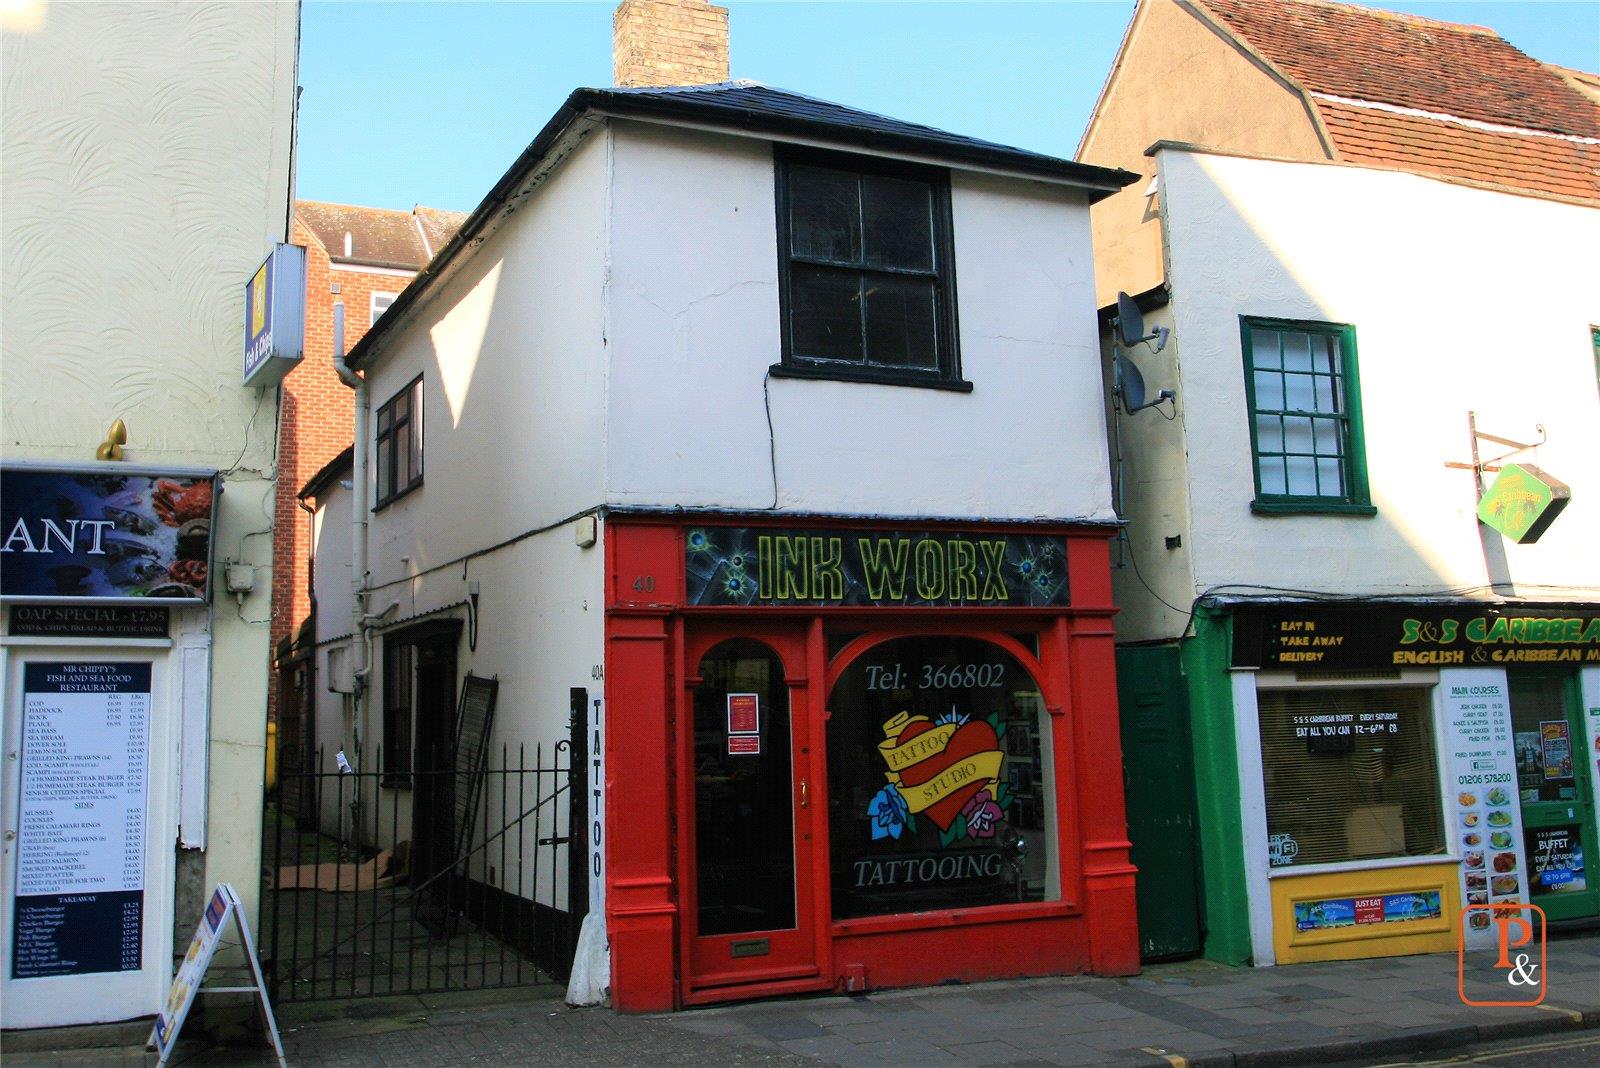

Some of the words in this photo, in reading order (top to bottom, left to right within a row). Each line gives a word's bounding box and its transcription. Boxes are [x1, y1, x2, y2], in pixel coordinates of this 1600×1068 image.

[758, 535, 844, 600] INK
[858, 538, 1009, 601] WORX
[632, 576, 656, 592] 40
[18, 608, 51, 620] OAP
[55, 608, 120, 621] SPECIAL
[1281, 621, 1303, 631] EAT
[1305, 622, 1315, 631] IN
[1400, 618, 1459, 644] S&S
[1280, 636, 1310, 646] TAKE
[1312, 636, 1344, 646] AWAY
[1280, 652, 1324, 662] DELIVERY
[1393, 650, 1464, 664] ENGLISH
[1471, 646, 1489, 662] &
[1491, 649, 1582, 662] CARIBBEAN
[591, 665, 604, 680] 40A
[865, 663, 908, 690] Tel:
[918, 663, 1005, 689] 366802
[60, 684, 118, 692] RESTAURANT
[1452, 687, 1468, 695] MAIN
[1470, 686, 1500, 695] COURSES
[1310, 715, 1335, 723] CARIBBEAN
[1336, 714, 1354, 722] BUFFET
[1375, 712, 1398, 721] SATURDAY
[1296, 728, 1308, 737] EAT
[1310, 727, 1321, 736] ALL
[1322, 726, 1336, 736] YOU
[1338, 726, 1350, 735] CAN
[888, 731, 950, 766] TATTOO
[922, 763, 976, 803] STUDIO
[1458, 774, 1482, 784] 01206
[1484, 773, 1511, 783] 578200
[593, 700, 601, 878] TATTOO
[1538, 838, 1568, 850] BUFFET
[853, 853, 1002, 886] TATTOOING
[1355, 900, 1369, 908] JUST
[1370, 898, 1382, 906] EAT
